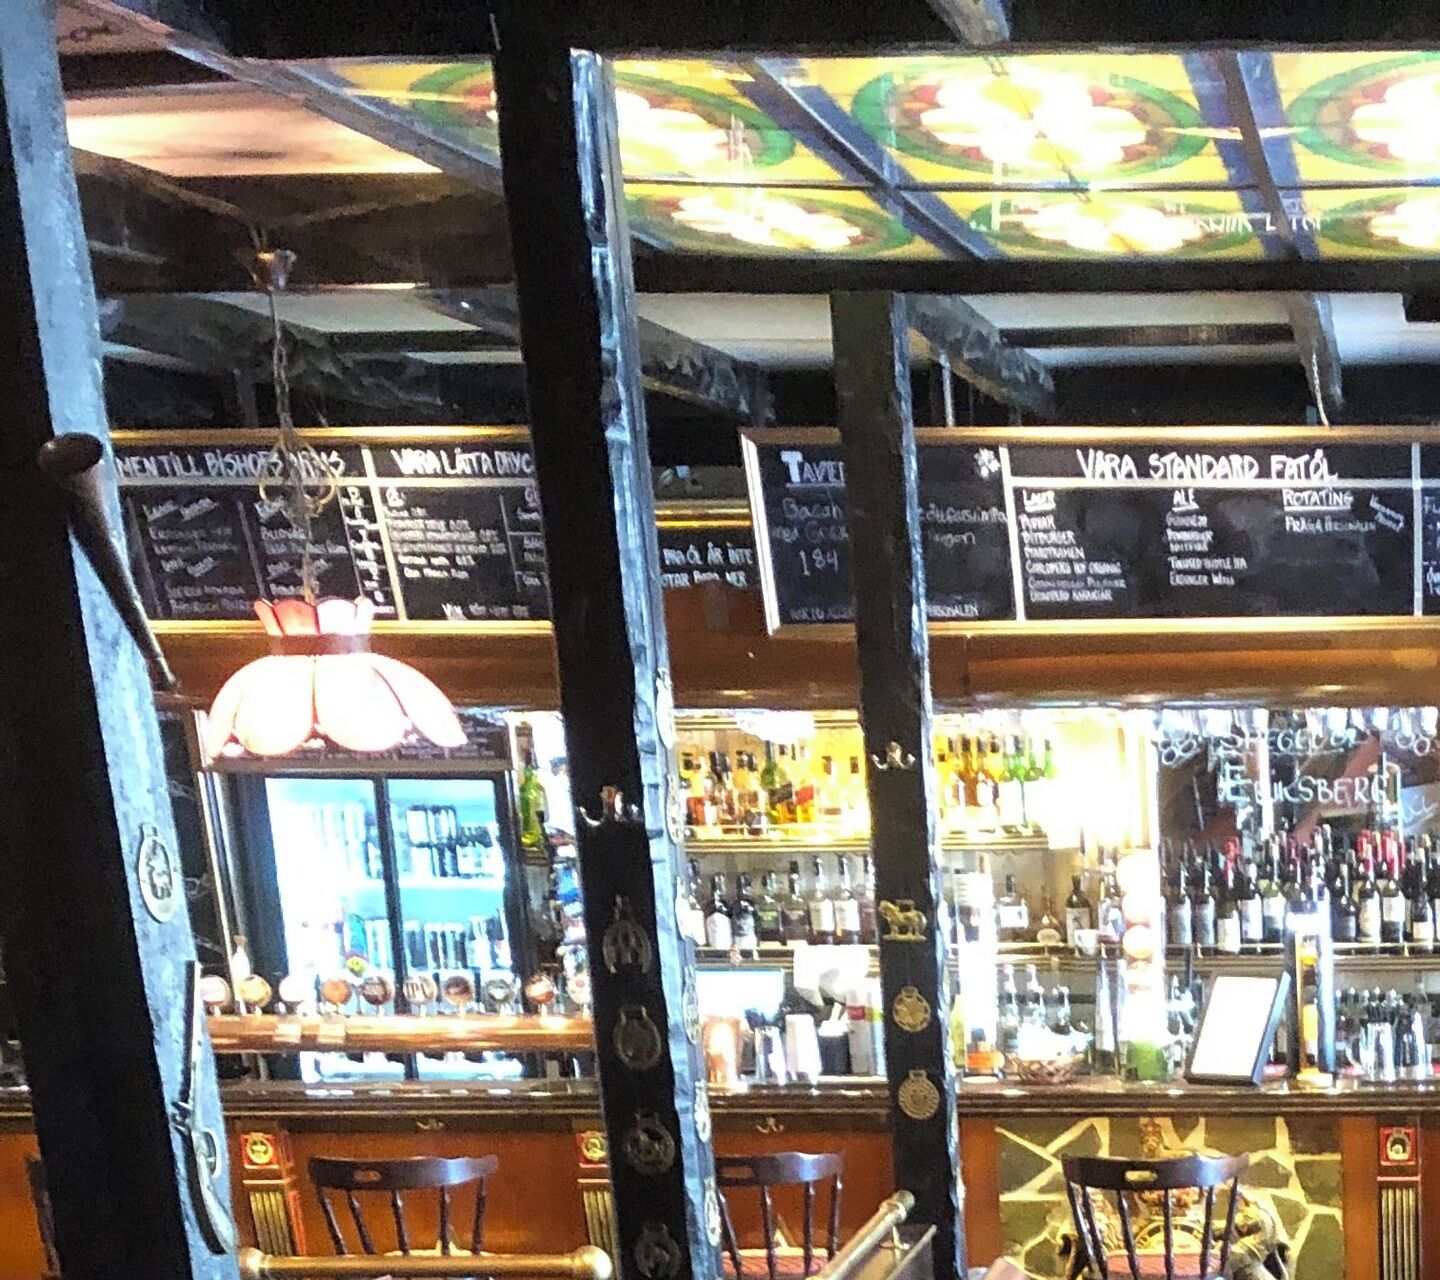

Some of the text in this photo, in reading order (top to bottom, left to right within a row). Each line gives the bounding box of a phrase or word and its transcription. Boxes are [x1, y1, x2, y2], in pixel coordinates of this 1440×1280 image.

[158, 451, 203, 477] TILL
[493, 450, 534, 475] DRYC
[1148, 451, 1259, 480] STANDARD
[1172, 488, 1197, 508] ALE
[1282, 487, 1354, 508] ROTATING
